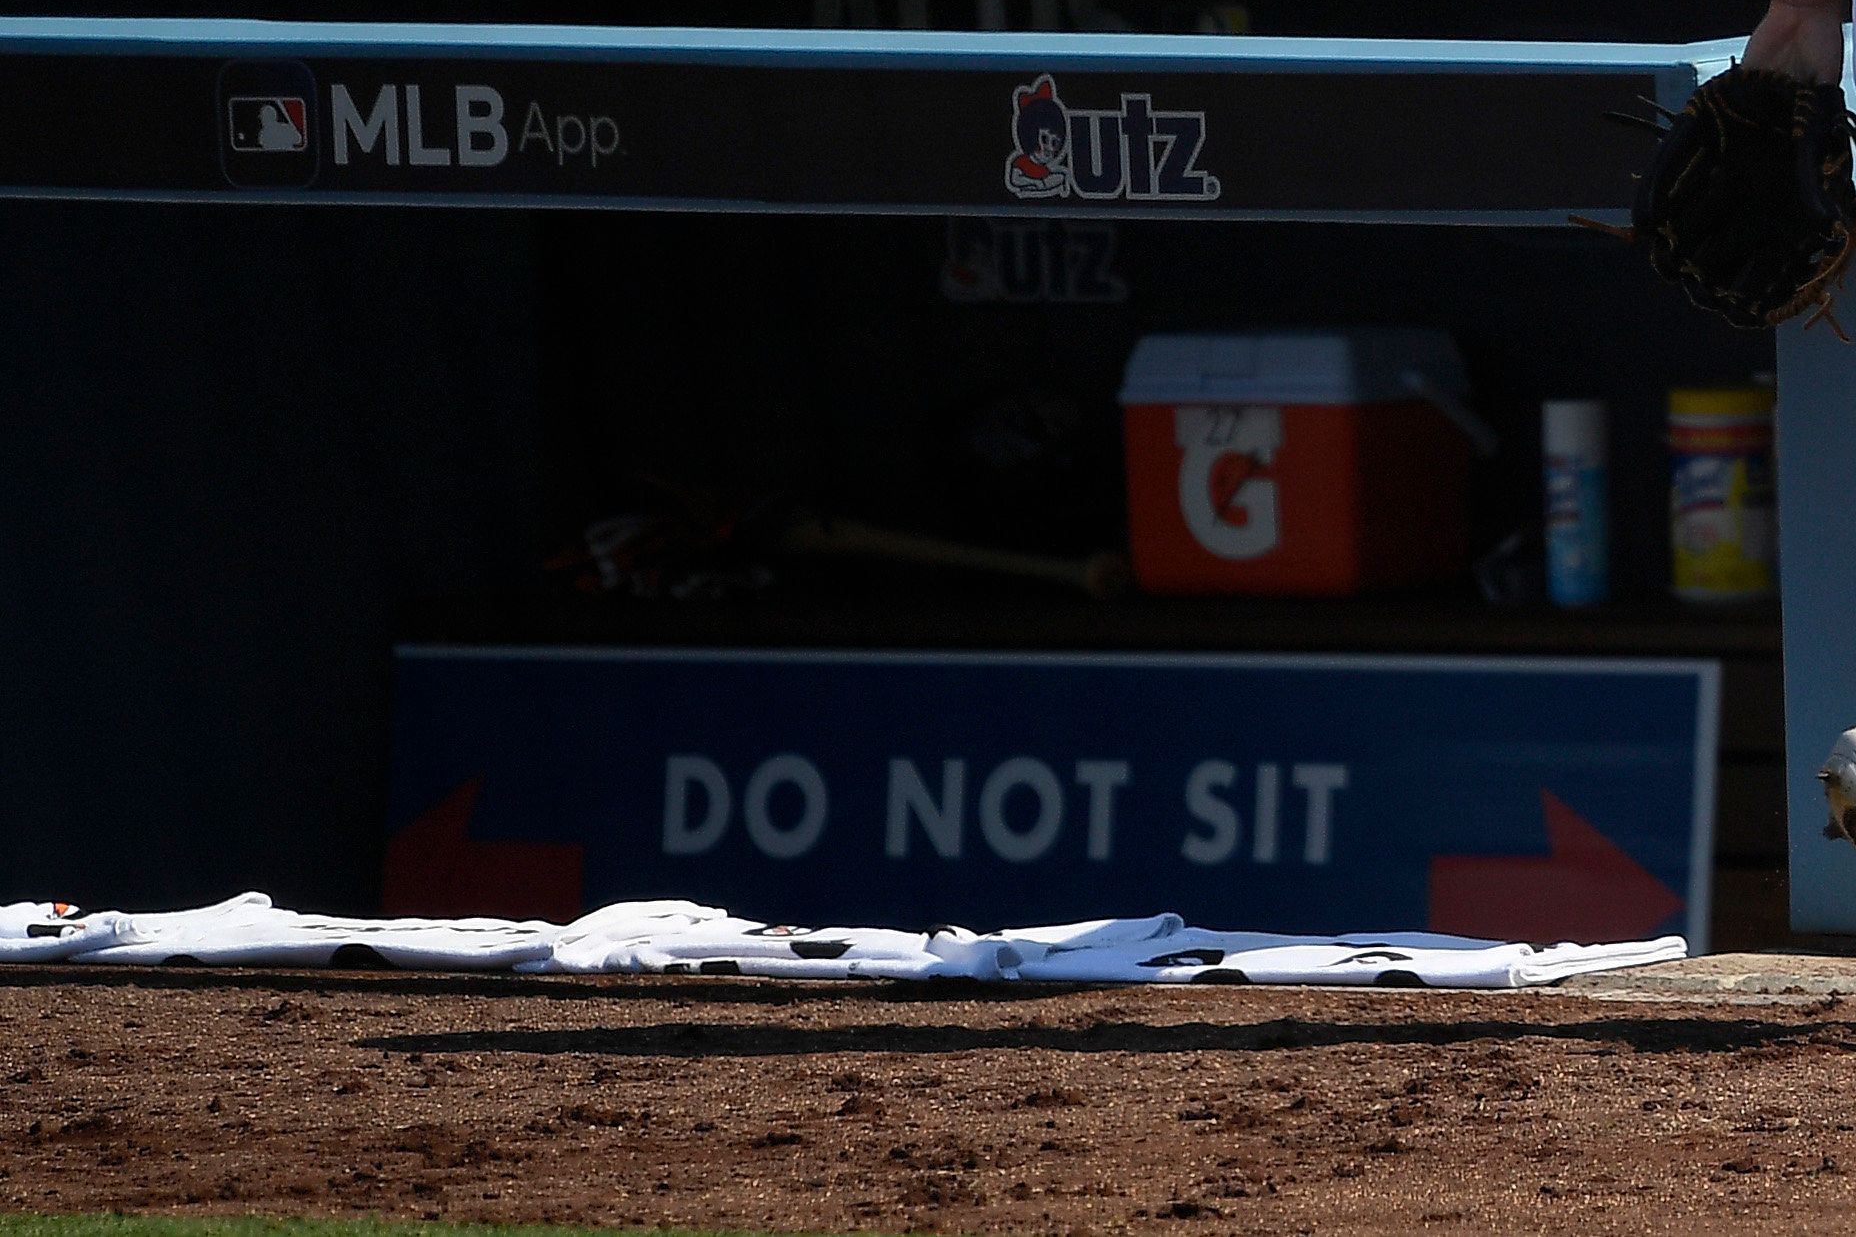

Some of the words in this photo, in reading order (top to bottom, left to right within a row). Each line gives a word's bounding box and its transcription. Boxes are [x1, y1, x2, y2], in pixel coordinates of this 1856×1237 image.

[328, 83, 510, 168] MLB
[518, 101, 622, 168] App
[1175, 430, 1282, 561] G
[661, 751, 831, 861] DO
[884, 755, 1132, 865] NOT
[1181, 759, 1352, 867] SIT
